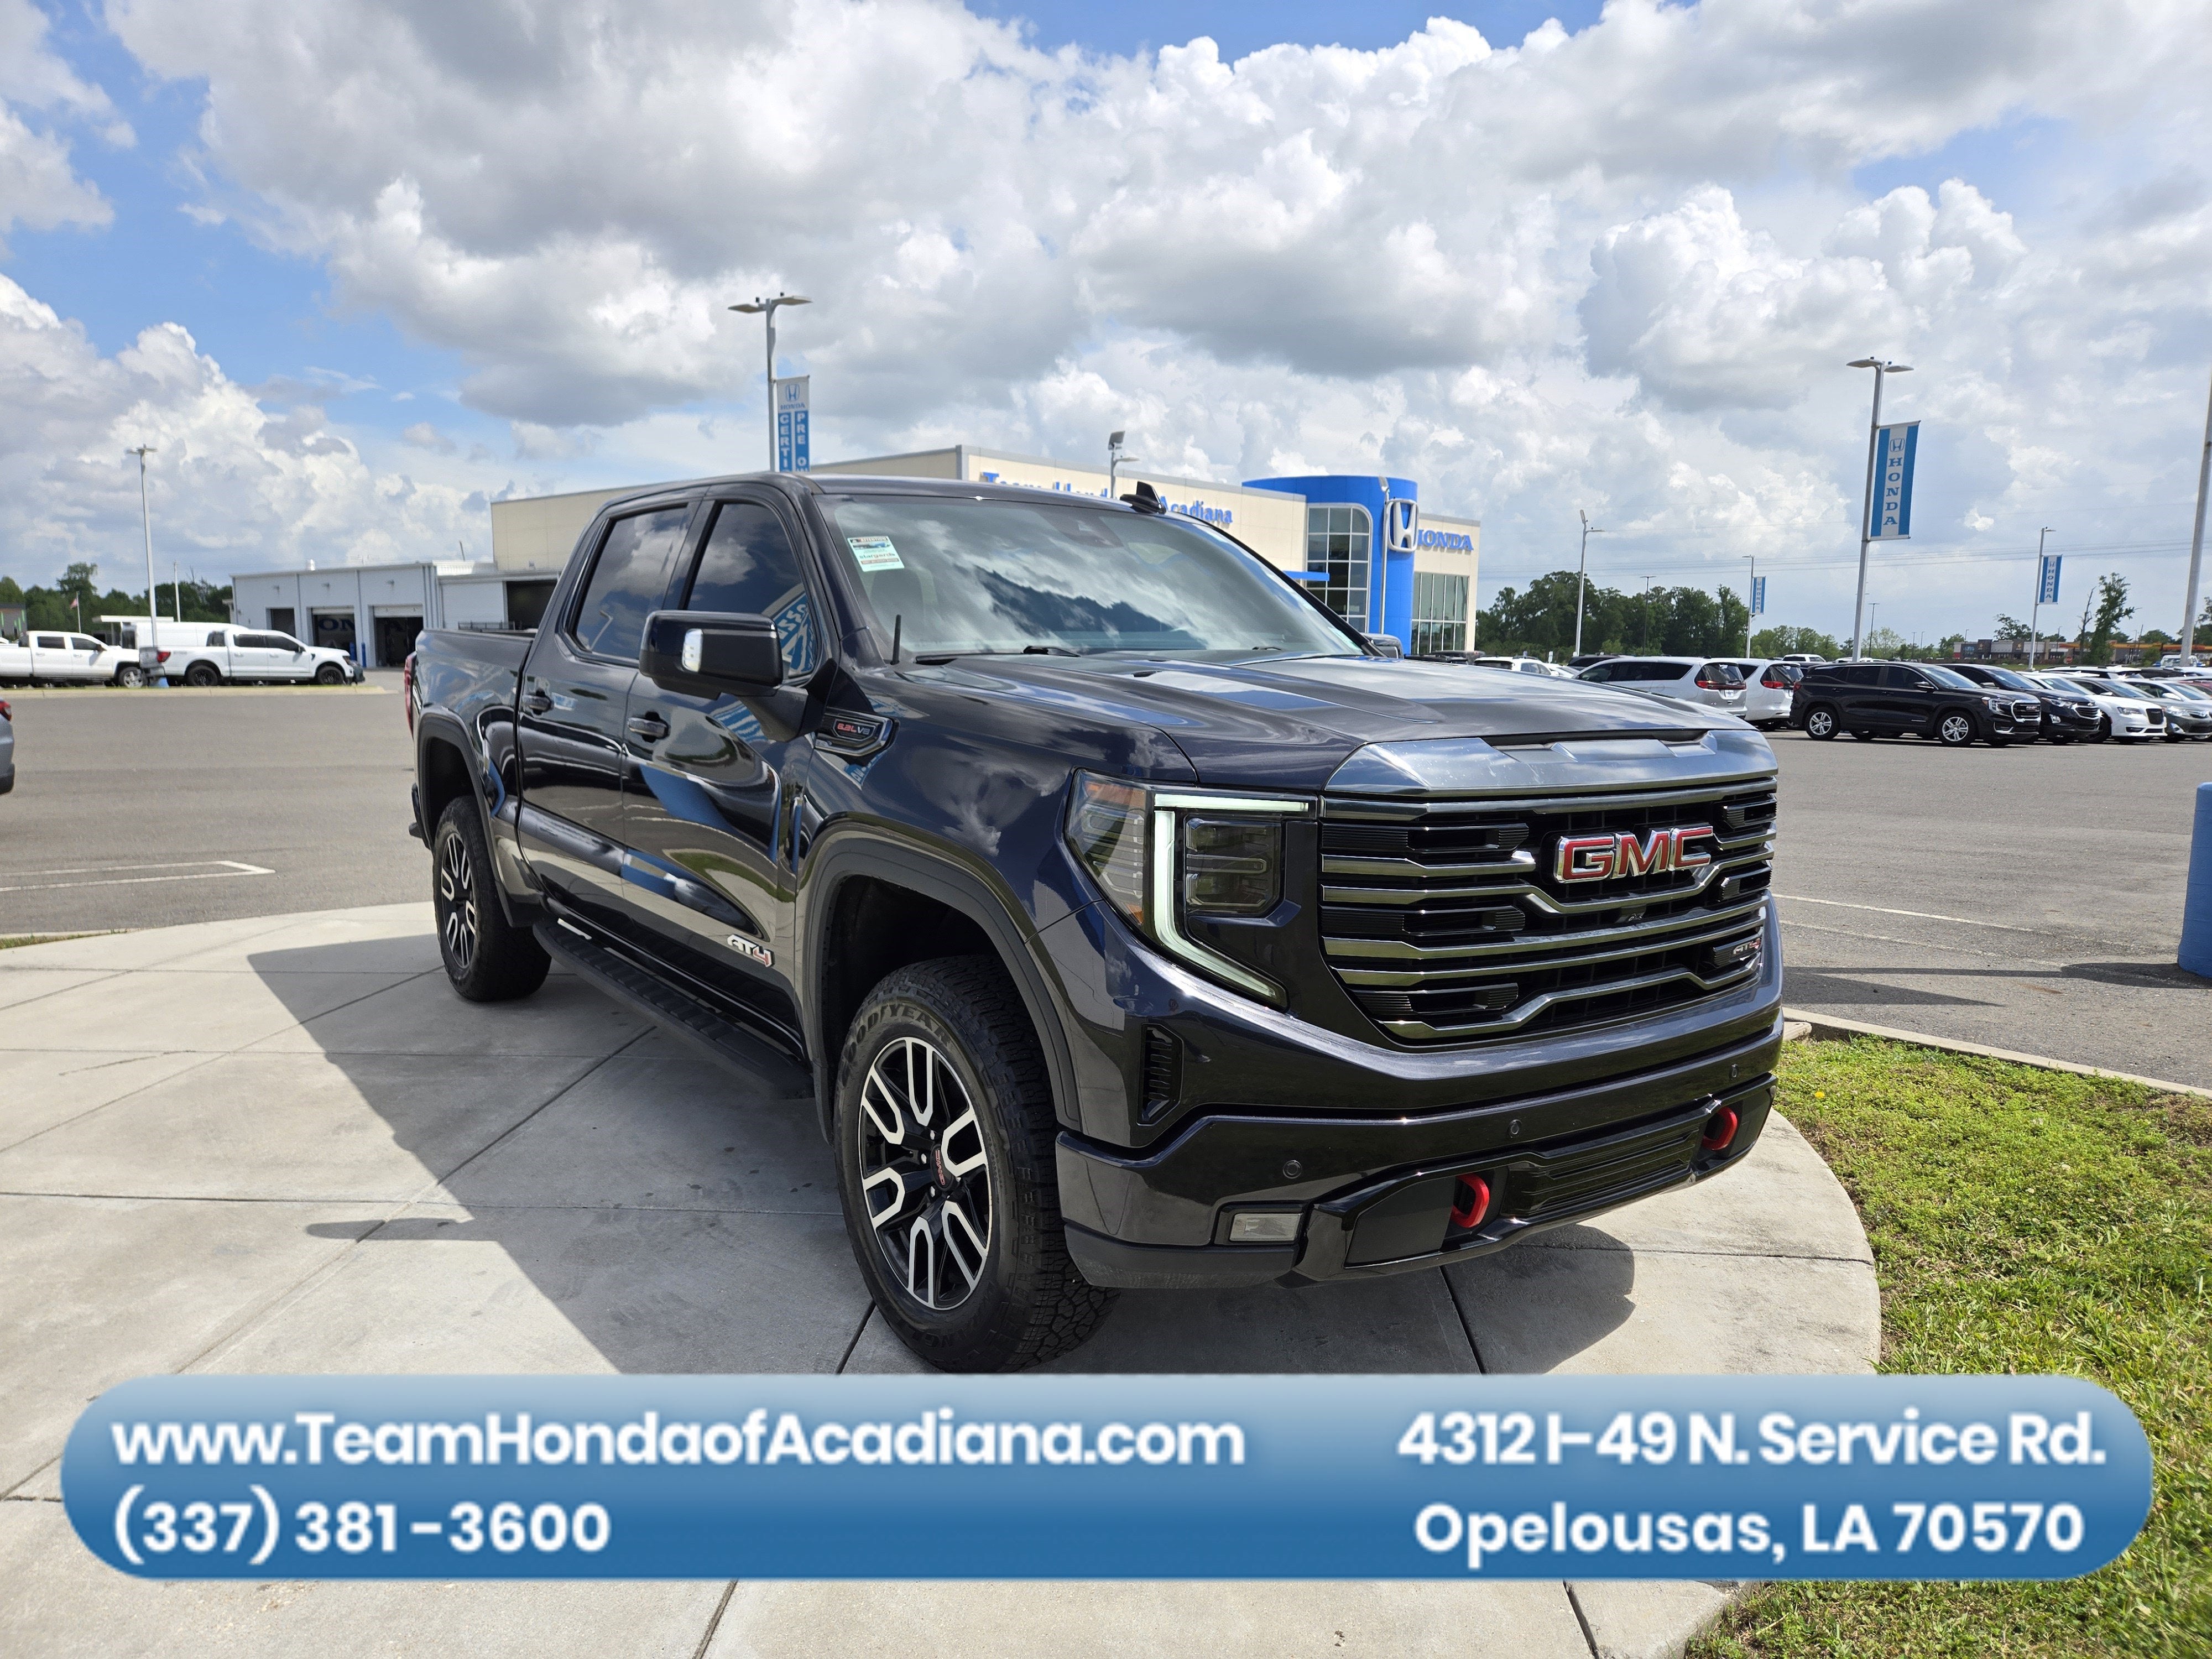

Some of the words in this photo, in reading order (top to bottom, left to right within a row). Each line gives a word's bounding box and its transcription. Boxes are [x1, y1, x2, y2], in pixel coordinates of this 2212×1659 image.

[780, 415, 790, 472] CERTI
[796, 413, 806, 444] PRE
[1883, 457, 1903, 525] HONDA
[2045, 569, 2055, 598] HONDA
[858, 726, 871, 735] V8
[1554, 826, 1713, 884] GMC
[727, 934, 773, 968] AT4
[1733, 937, 1761, 954] AT4
[930, 1149, 946, 1186] GMC
